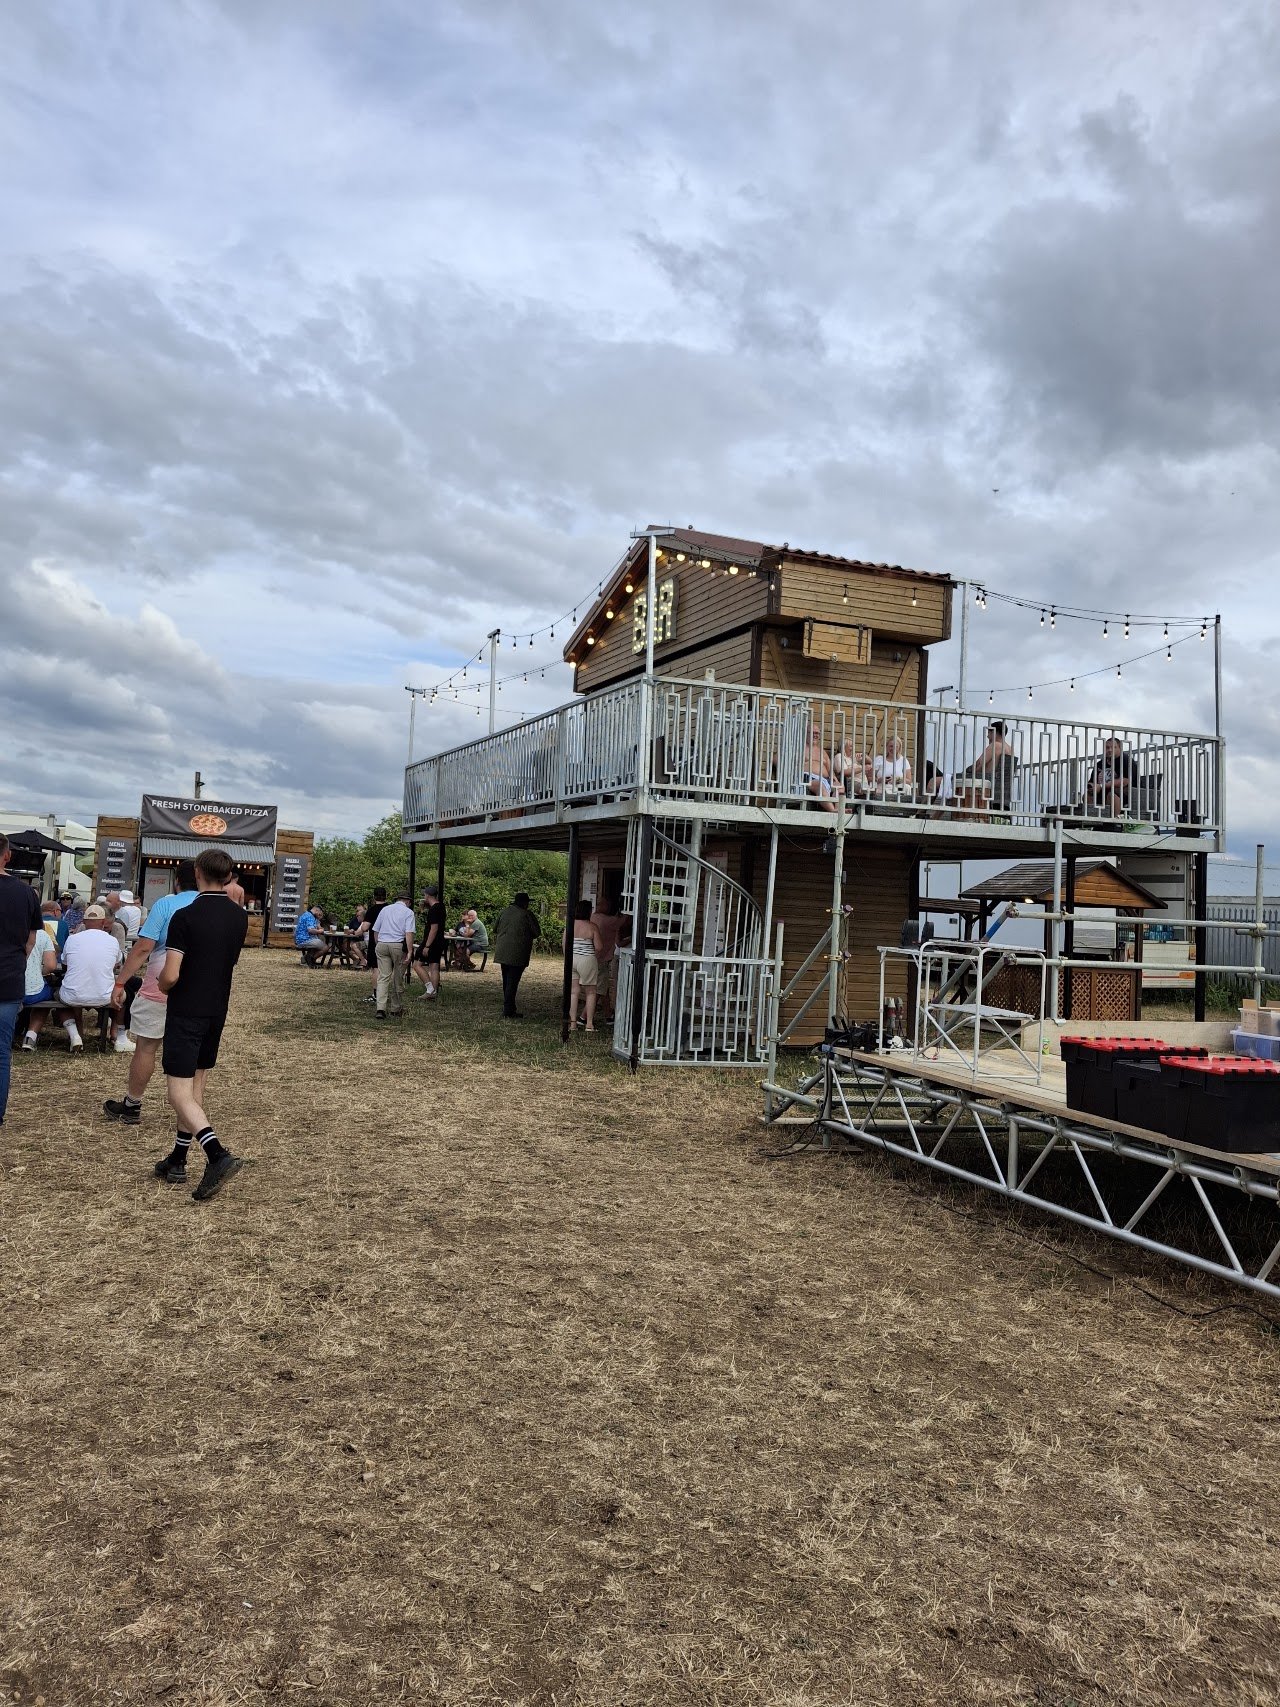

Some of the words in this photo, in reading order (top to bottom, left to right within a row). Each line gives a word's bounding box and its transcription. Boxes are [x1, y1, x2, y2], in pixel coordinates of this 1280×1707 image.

[152, 800, 181, 809] FRESH
[182, 803, 242, 815] STONEBAKED
[244, 808, 269, 817] PIZZA
